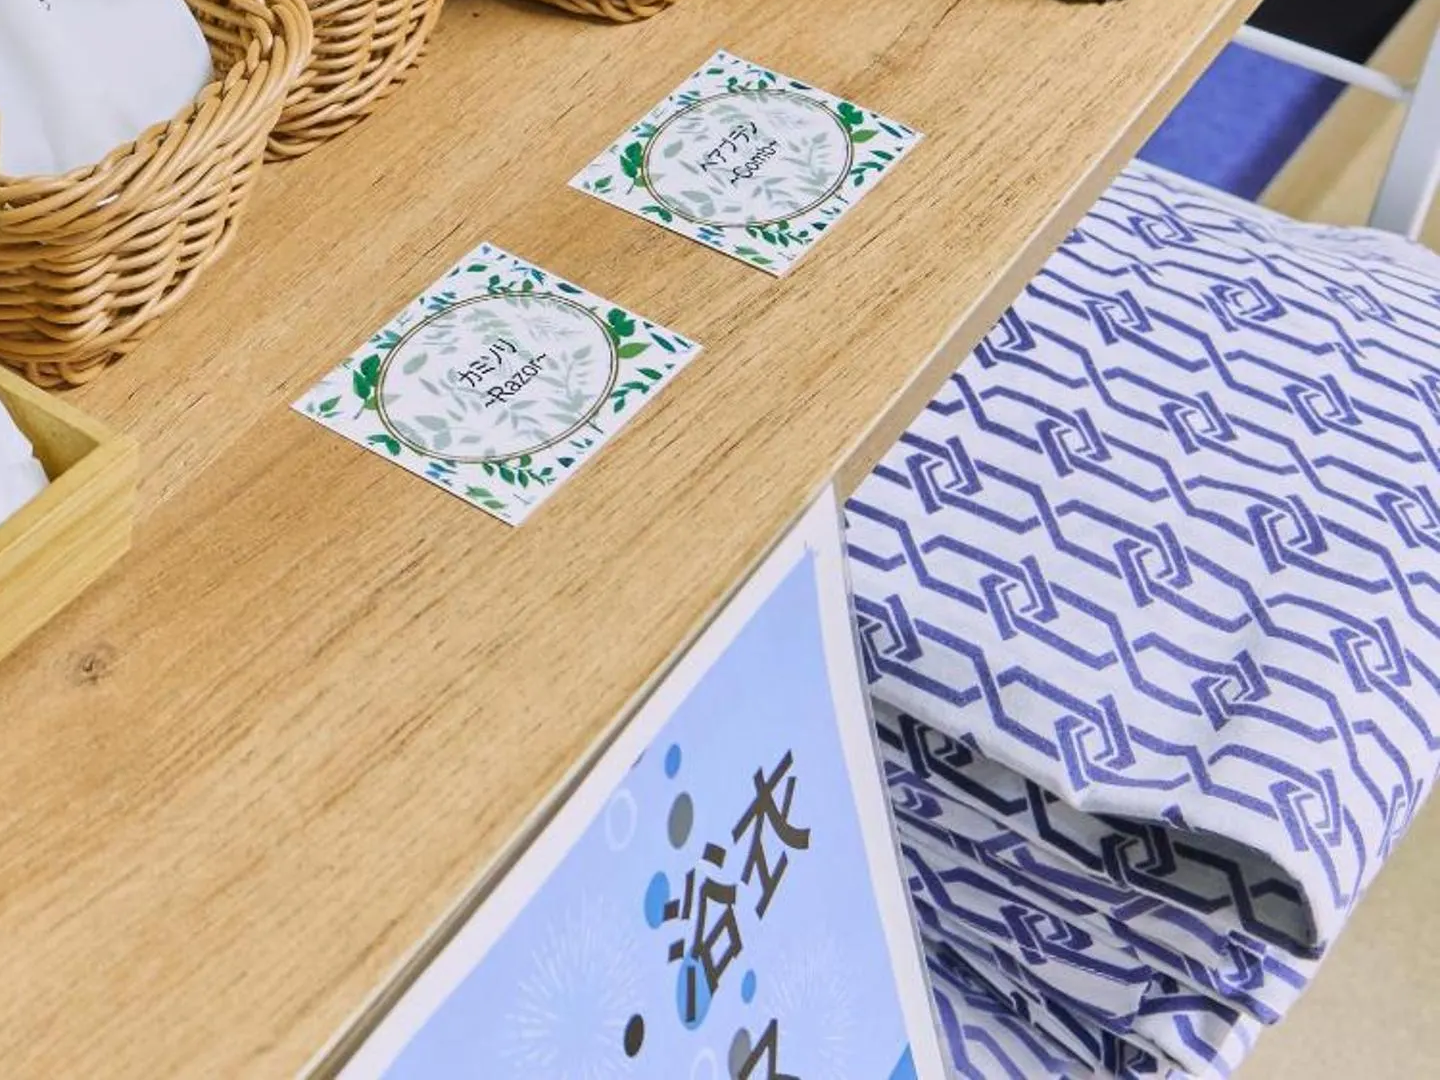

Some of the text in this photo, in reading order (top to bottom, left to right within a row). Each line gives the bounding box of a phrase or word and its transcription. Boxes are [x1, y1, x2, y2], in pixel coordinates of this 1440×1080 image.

[458, 338, 517, 388] カミソリ
[663, 747, 811, 1023] 浴衣
